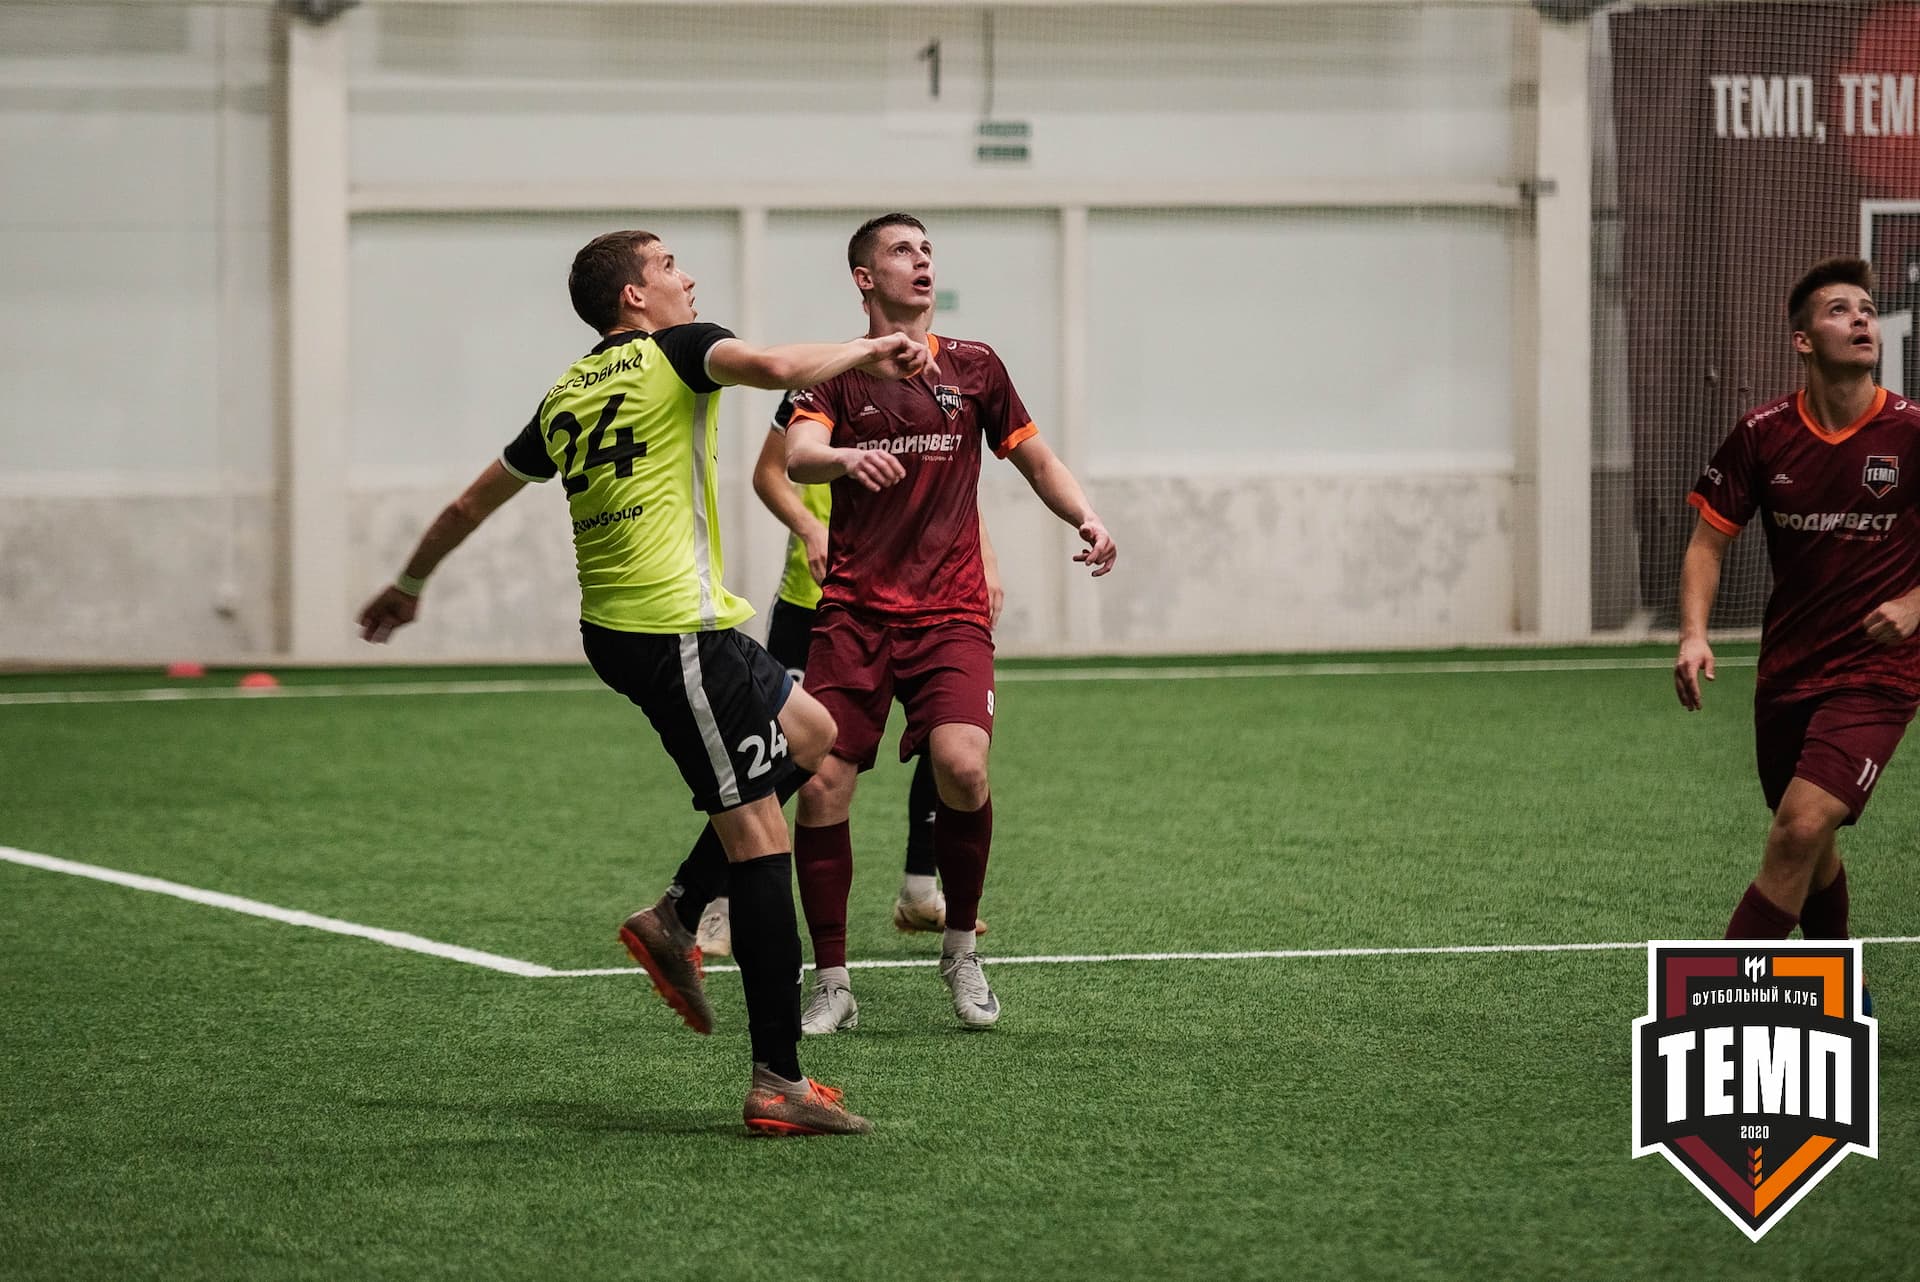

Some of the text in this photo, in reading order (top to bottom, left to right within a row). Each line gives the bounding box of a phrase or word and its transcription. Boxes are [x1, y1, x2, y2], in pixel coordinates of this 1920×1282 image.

[916, 40, 940, 98] 1
[1711, 74, 1920, 144] ТЕМП, ТЕМ
[546, 392, 647, 500] 24
[1866, 467, 1897, 483] ТЕМП
[987, 689, 995, 717] 9
[737, 719, 788, 780] 24
[1856, 757, 1878, 792] 11
